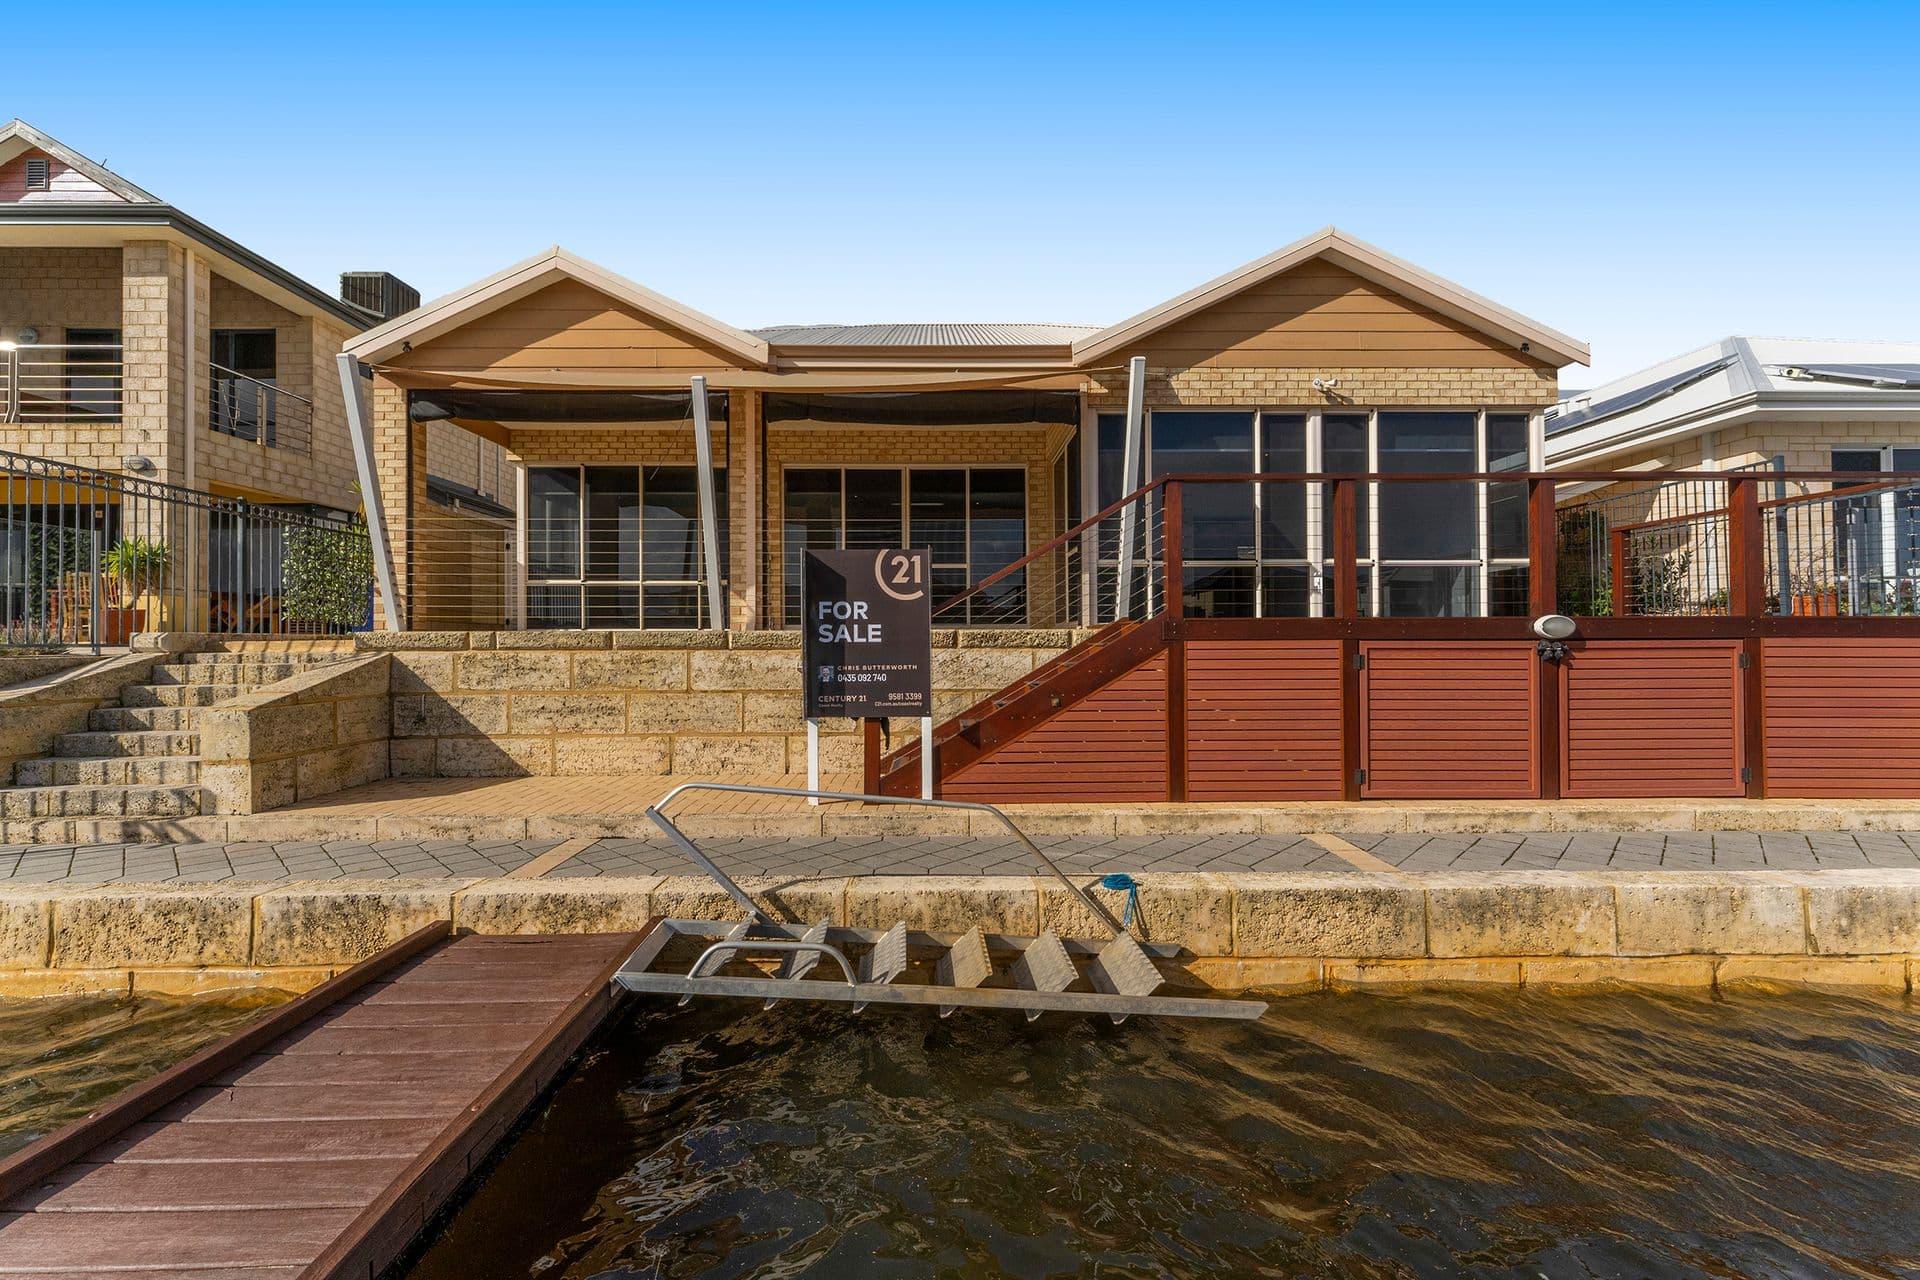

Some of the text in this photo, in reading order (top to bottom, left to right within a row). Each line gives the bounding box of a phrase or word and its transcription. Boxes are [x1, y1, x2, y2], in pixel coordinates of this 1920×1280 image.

[819, 601, 869, 620] FOR
[819, 624, 882, 643] SALE
[837, 673, 887, 682] 0435 092 740
[905, 692, 922, 701] 3399
